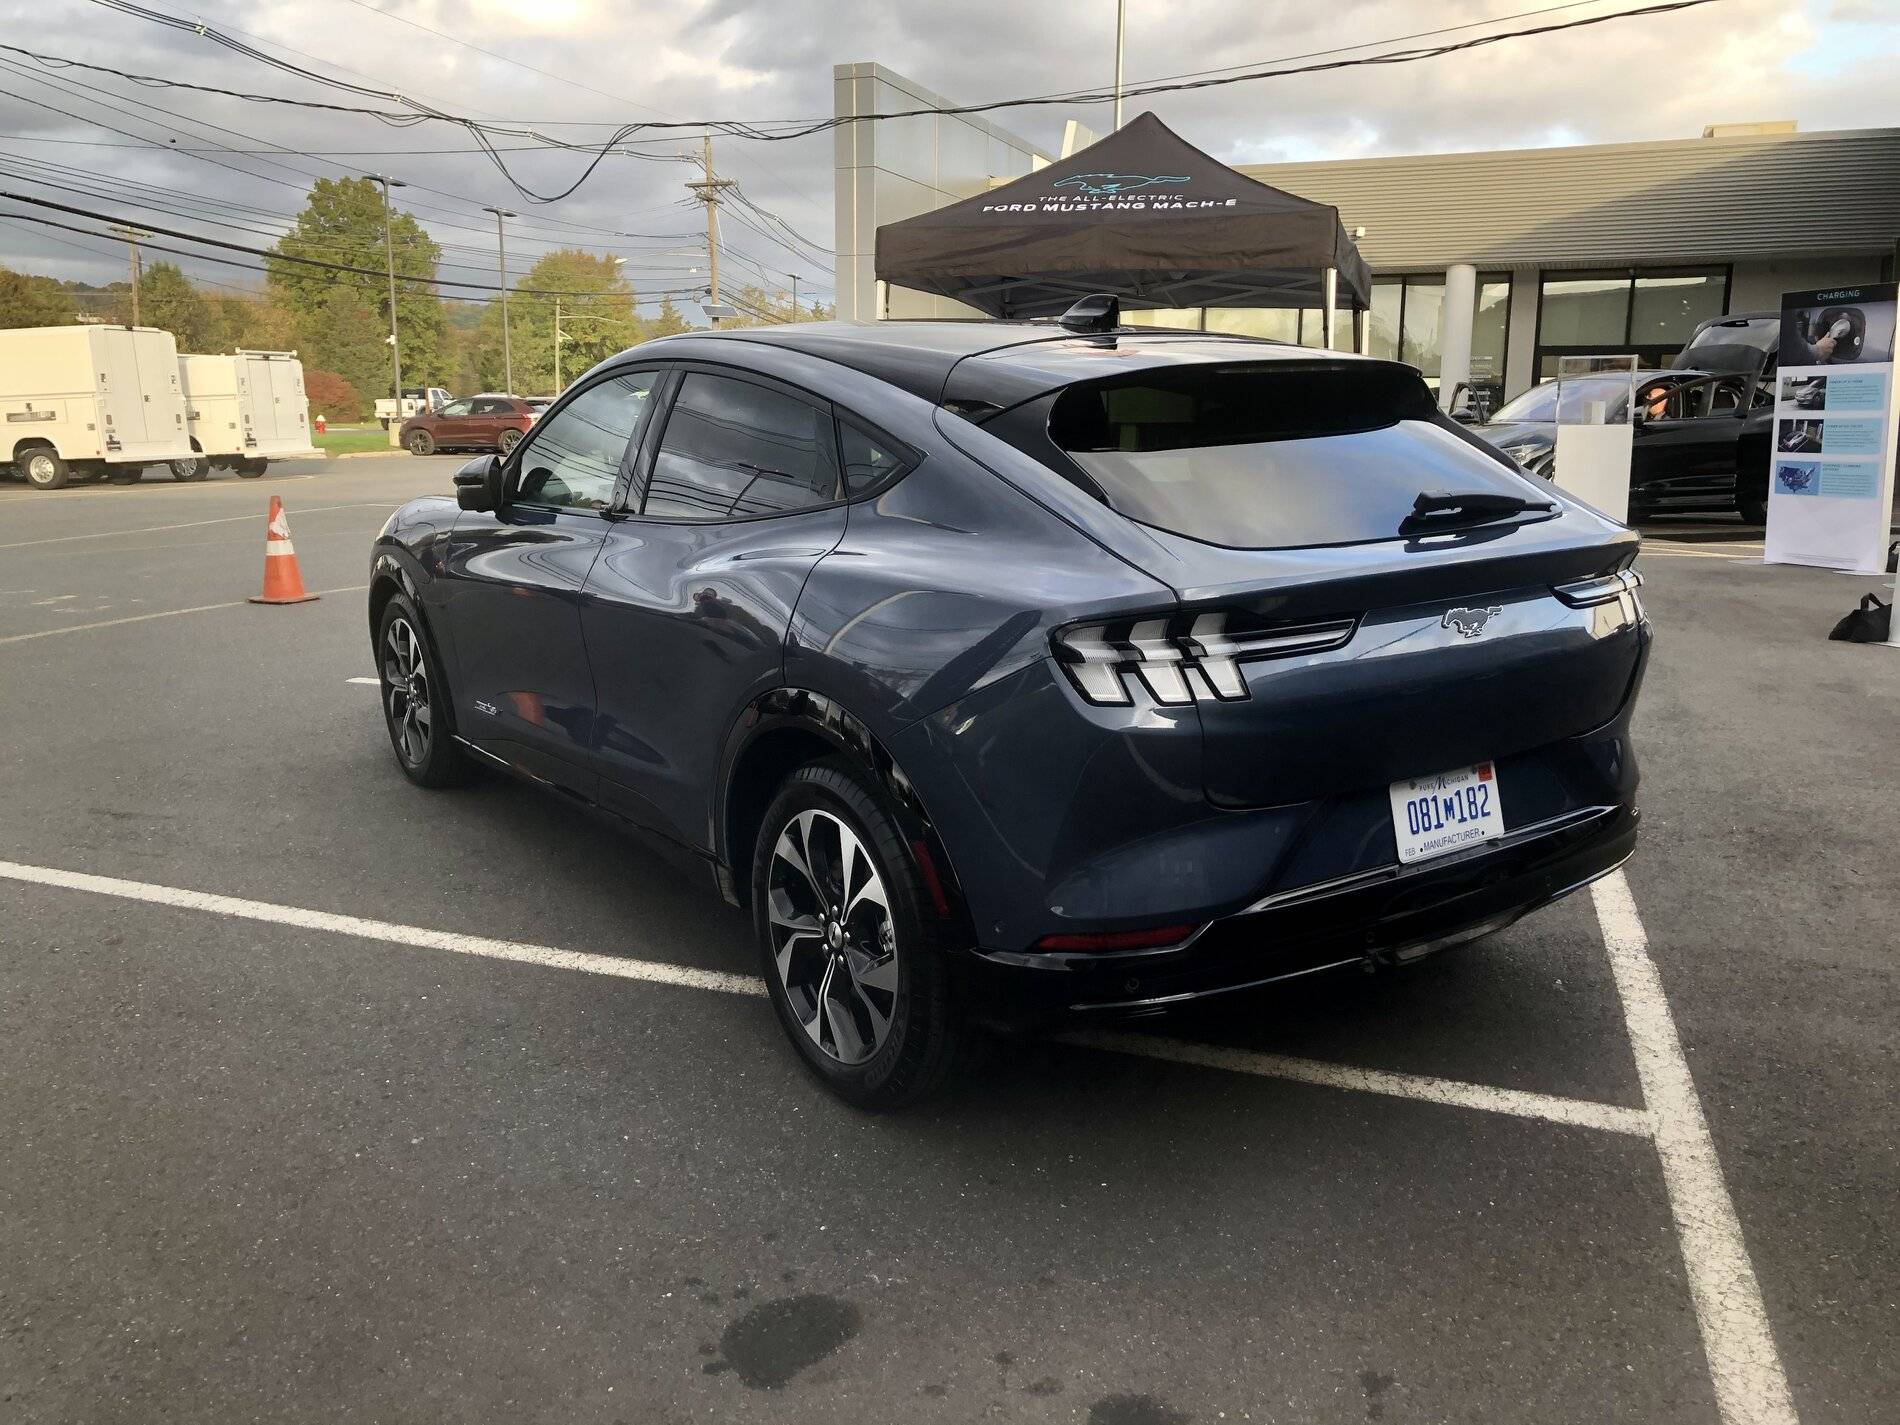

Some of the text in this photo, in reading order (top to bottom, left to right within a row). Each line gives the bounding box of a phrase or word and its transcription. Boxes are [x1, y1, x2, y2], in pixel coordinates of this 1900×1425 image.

[1072, 194, 1184, 202] ALL-ELECTRIC
[982, 199, 1237, 213] FORD MUSTANG MACH-E
[1817, 290, 1860, 301] CHARGING
[1405, 828, 1480, 857] FEB MANUFACTURER
